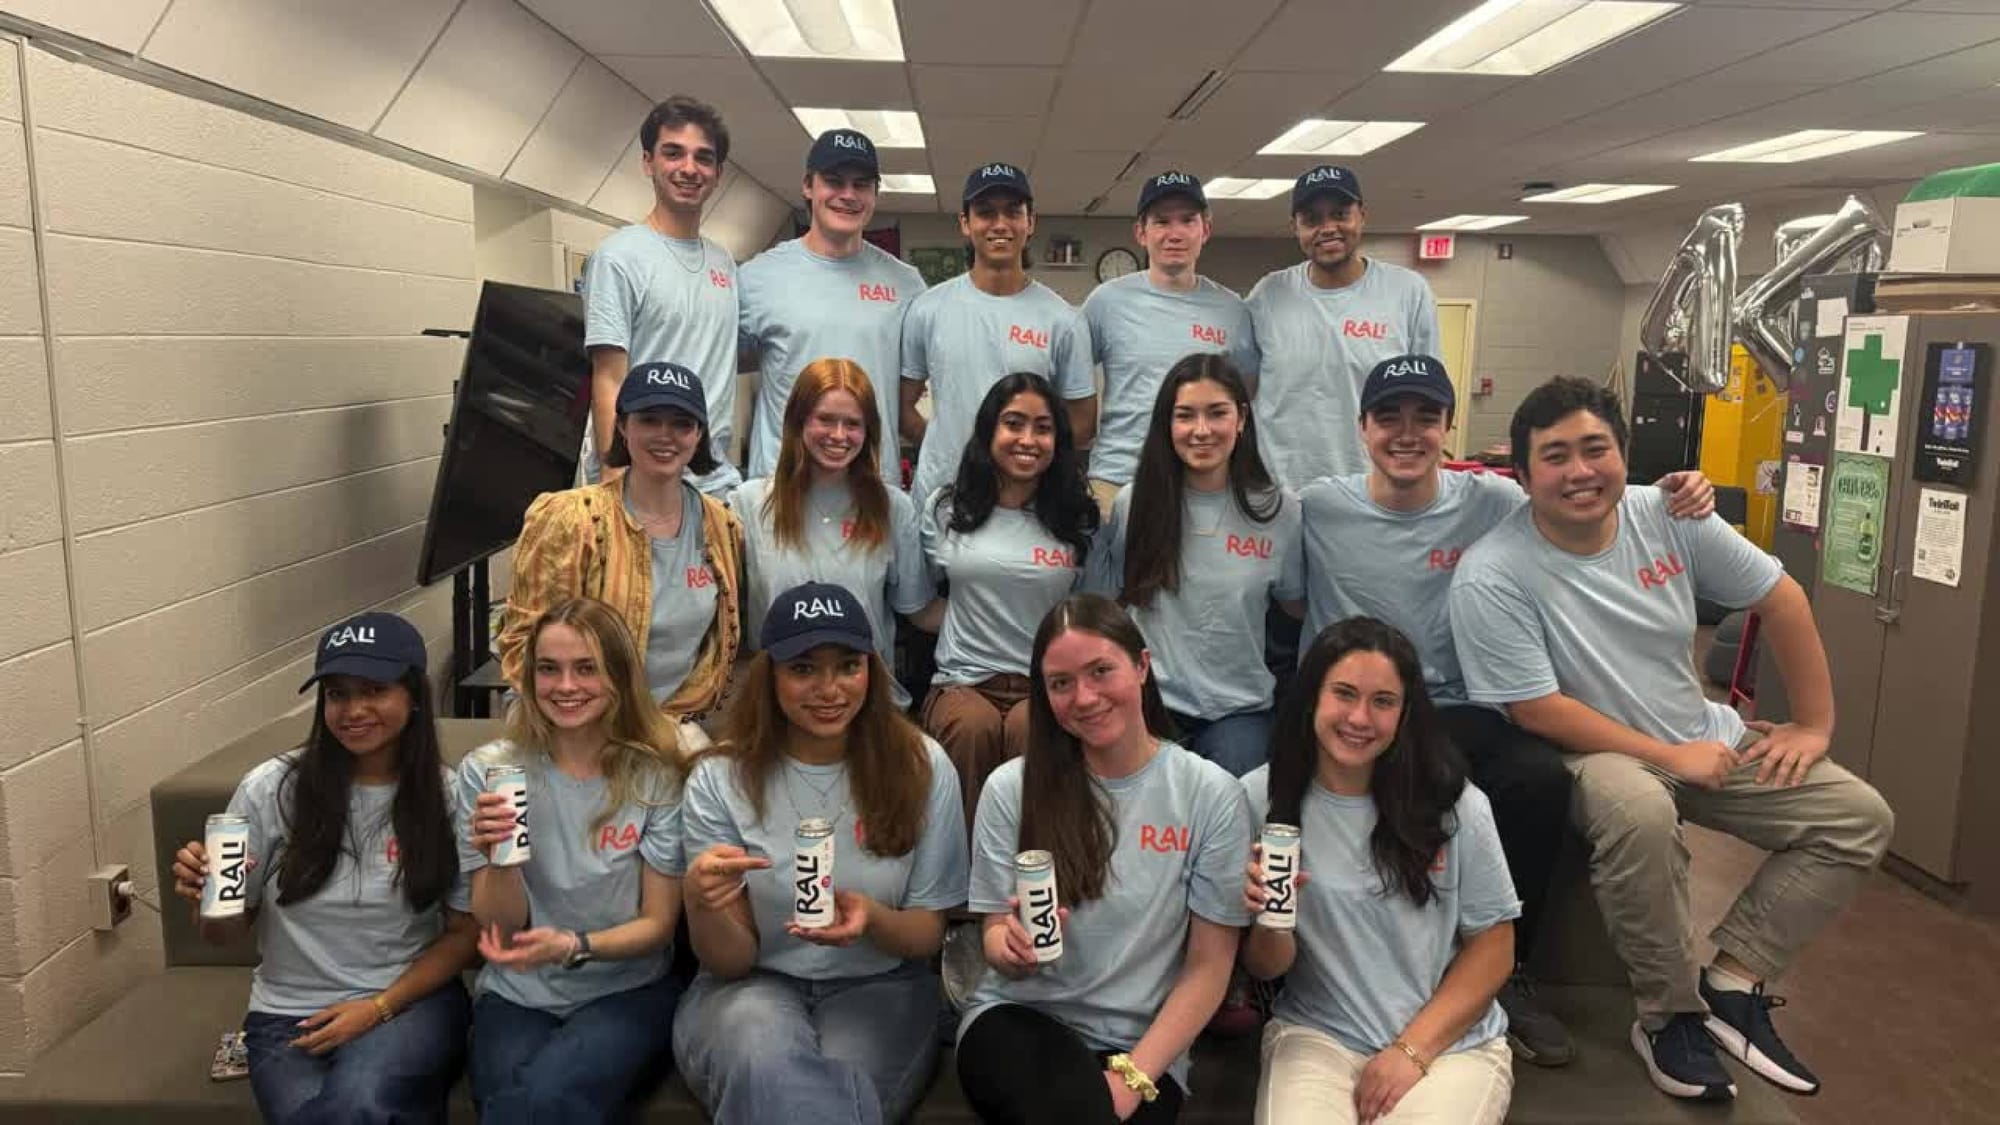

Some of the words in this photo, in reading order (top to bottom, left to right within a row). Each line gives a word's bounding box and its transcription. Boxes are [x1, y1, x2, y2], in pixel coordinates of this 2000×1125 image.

[834, 135, 868, 153] RALI
[982, 164, 1016, 180] RALI
[1156, 173, 1191, 187] RALI
[1306, 168, 1342, 185] RALI
[1426, 237, 1450, 257] EXIT
[858, 283, 898, 303] RALI
[1008, 324, 1048, 348] RALI
[1192, 324, 1226, 346] RALI
[1343, 319, 1387, 340] RALI
[647, 368, 692, 390] RALI
[1384, 360, 1429, 380] RALI
[1226, 534, 1272, 560] RALI
[1429, 547, 1461, 572] RA
[687, 565, 715, 588] RA
[794, 597, 845, 621] RALI
[325, 626, 376, 650] RALI
[599, 823, 640, 850] RA
[219, 841, 246, 901] RALI
[796, 854, 825, 915] RALI
[1265, 854, 1294, 914] RALI
[1029, 886, 1062, 949] RALI
